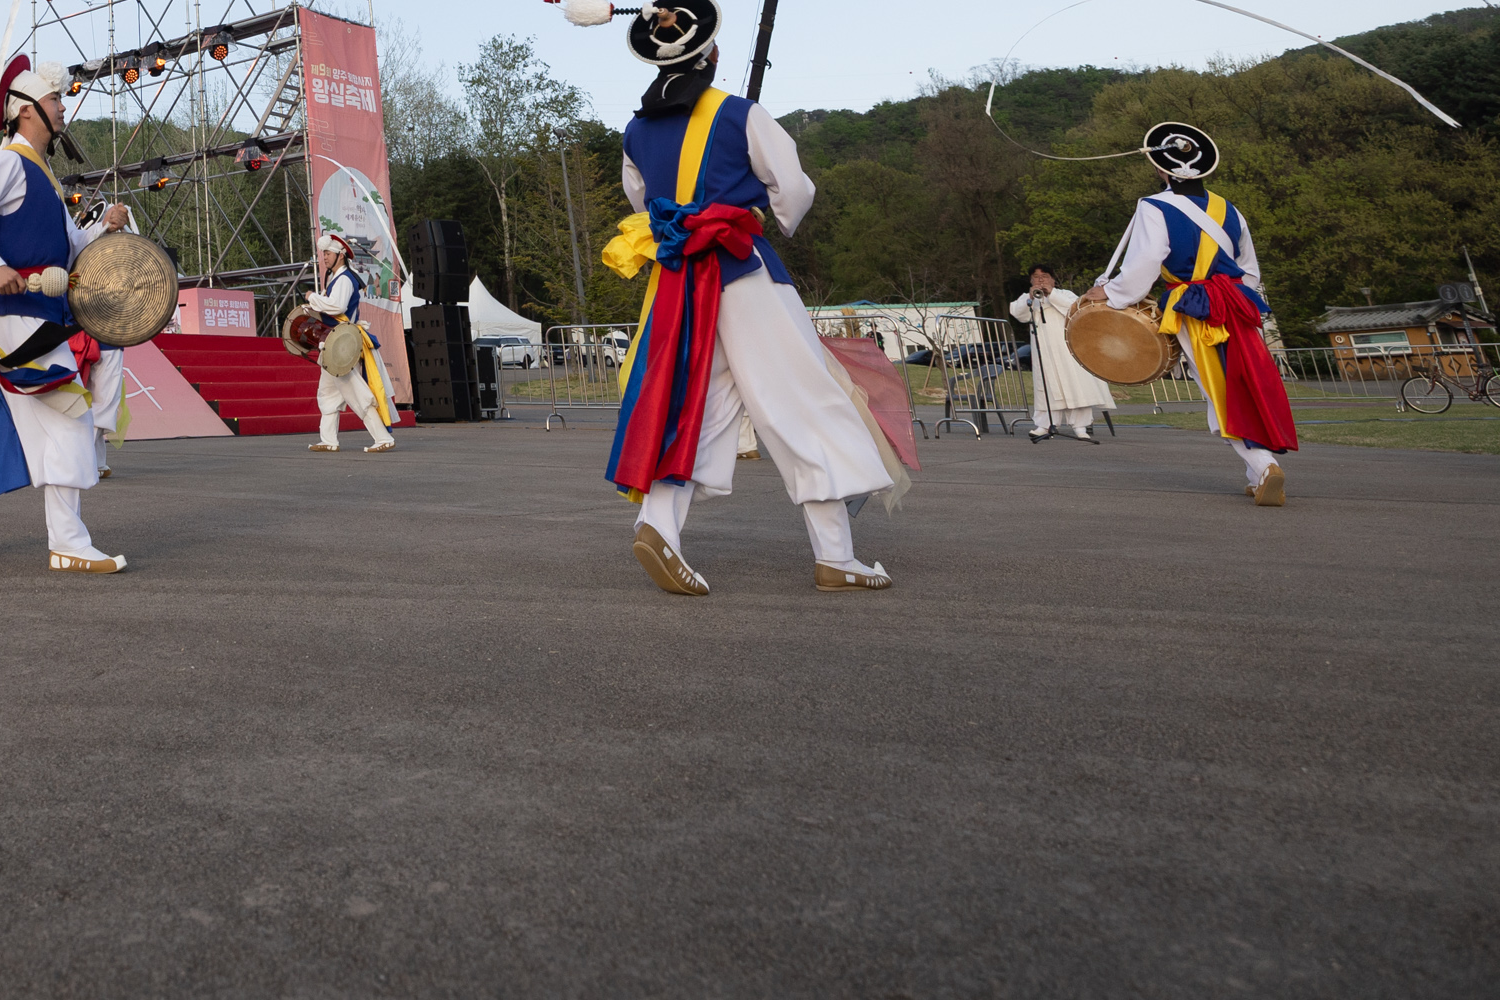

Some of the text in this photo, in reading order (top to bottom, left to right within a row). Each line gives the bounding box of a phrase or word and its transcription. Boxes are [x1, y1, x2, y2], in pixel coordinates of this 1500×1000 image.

[332, 68, 347, 80] 양주
[312, 78, 377, 113] 왕실축제
[204, 308, 251, 329] 왕실축제
